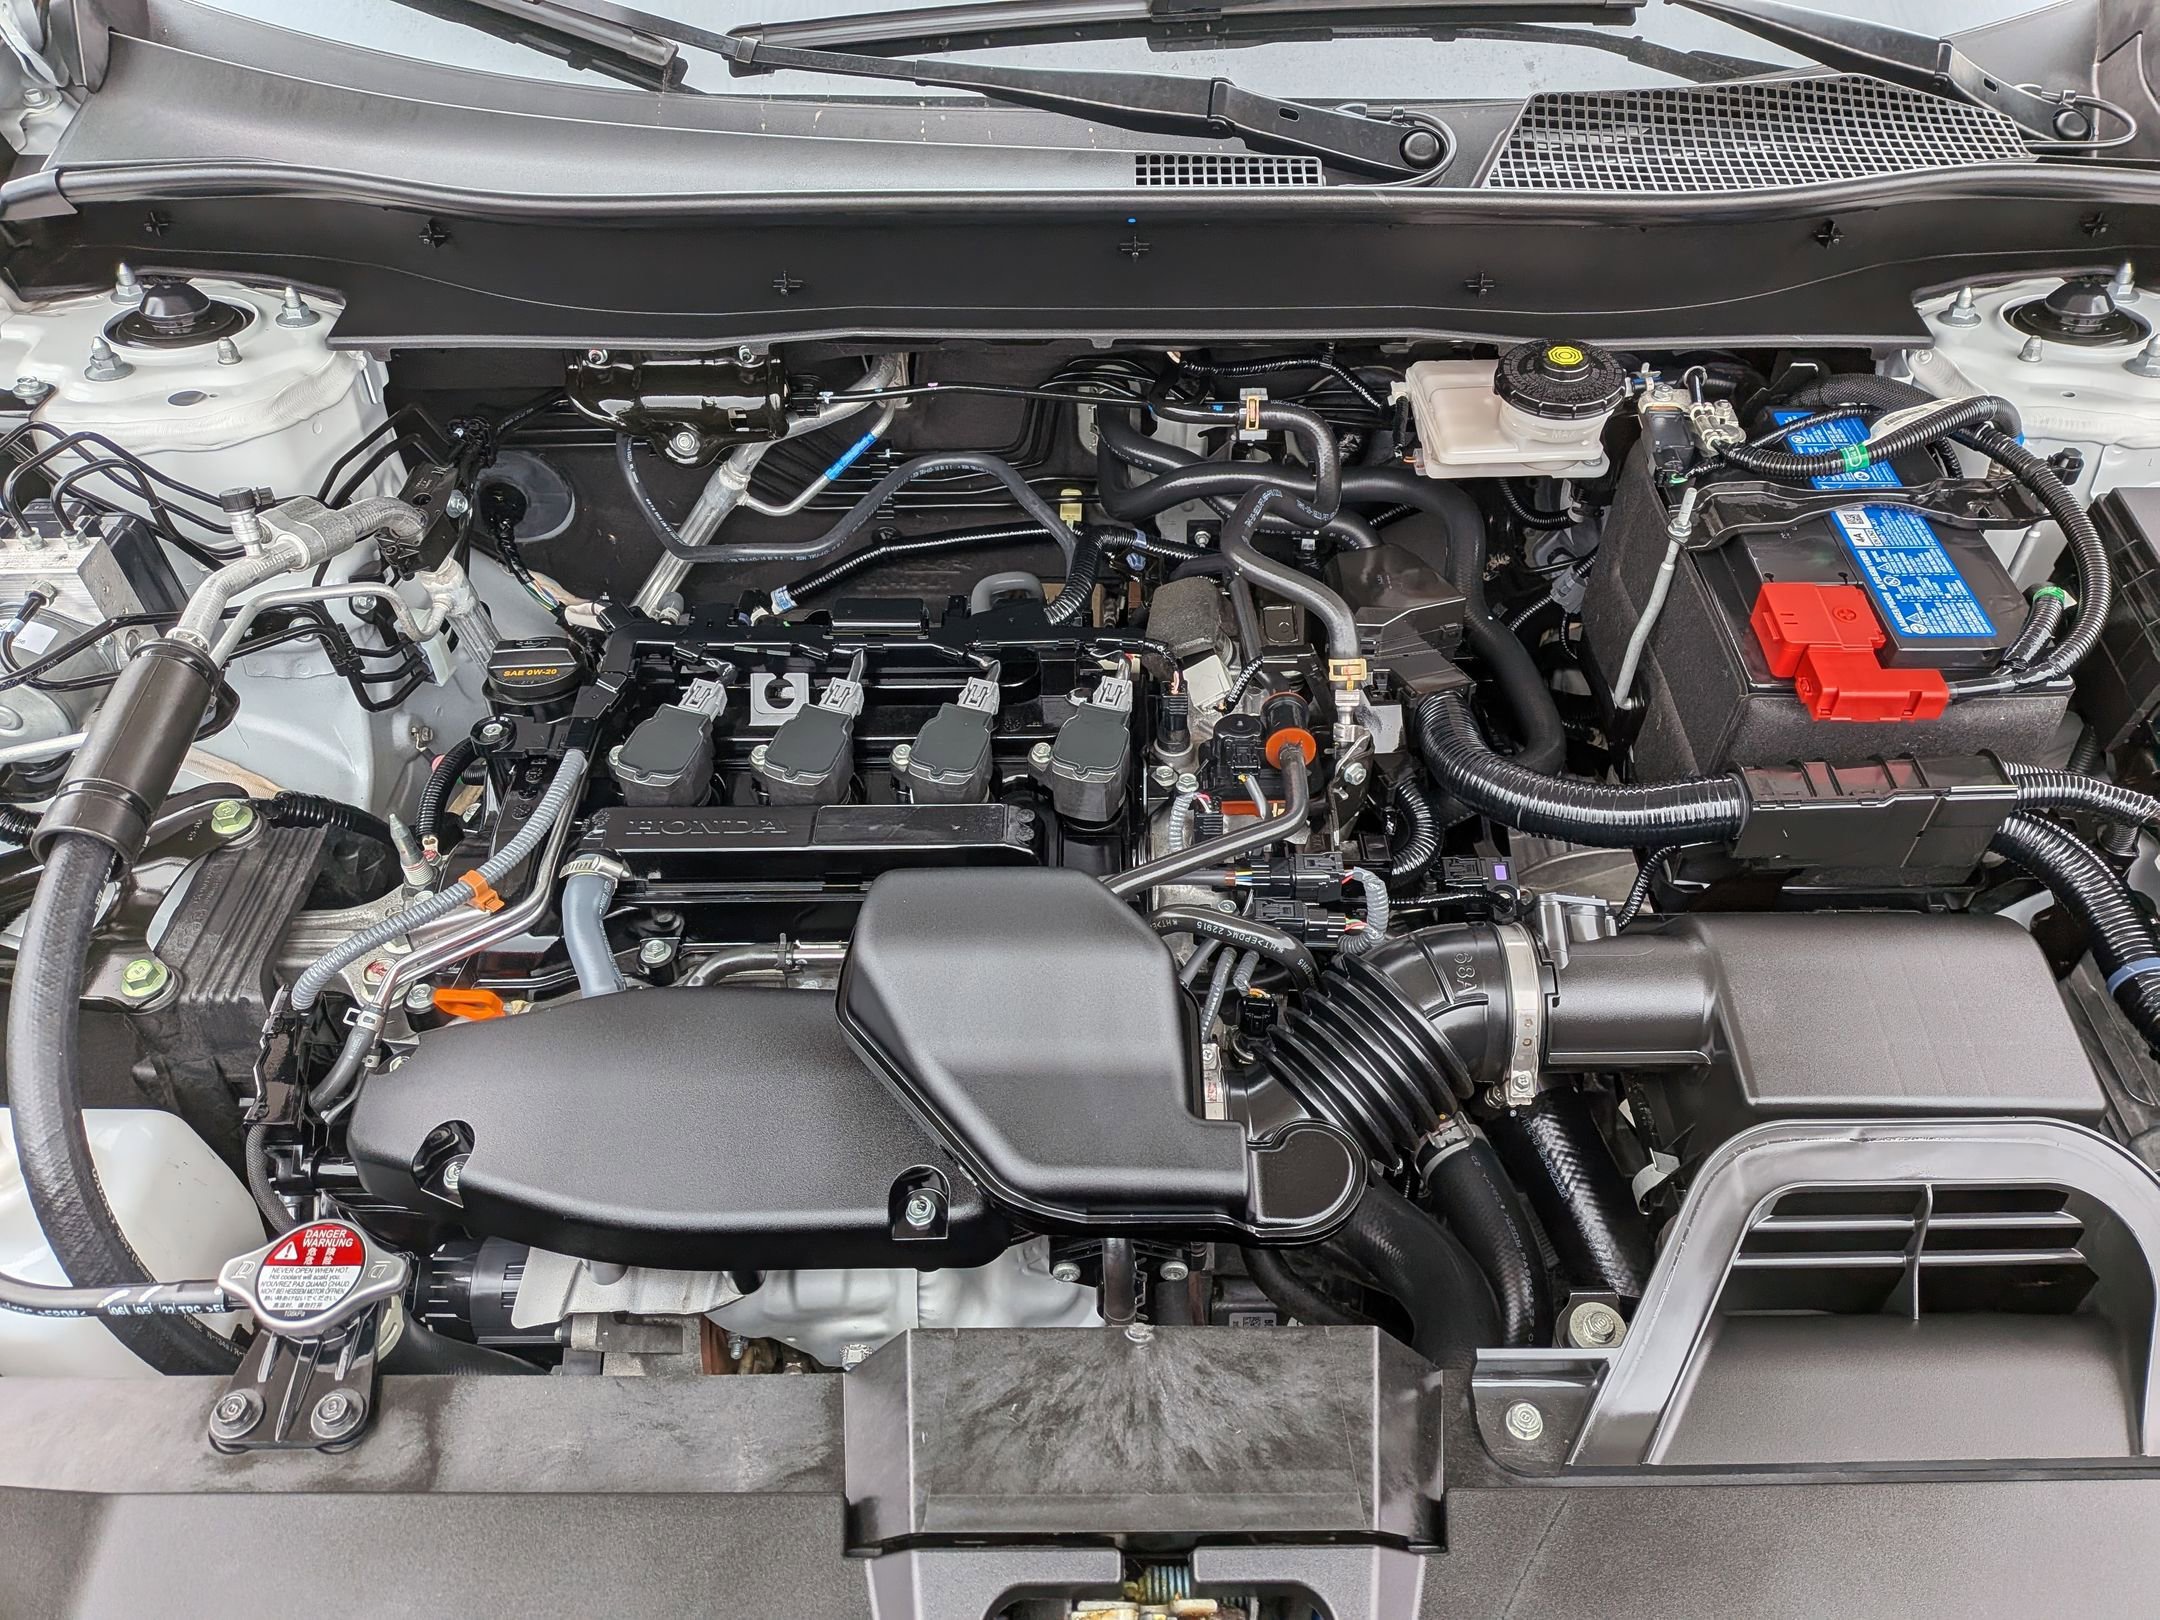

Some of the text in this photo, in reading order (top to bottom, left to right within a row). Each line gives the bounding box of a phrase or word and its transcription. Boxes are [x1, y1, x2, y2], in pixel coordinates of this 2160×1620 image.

[503, 668, 557, 677] SAE 0W-20
[625, 819, 791, 835] HONDA
[1196, 921, 1224, 935] 22915
[304, 1229, 348, 1239] DANGER
[302, 1238, 354, 1248] WARNUNG
